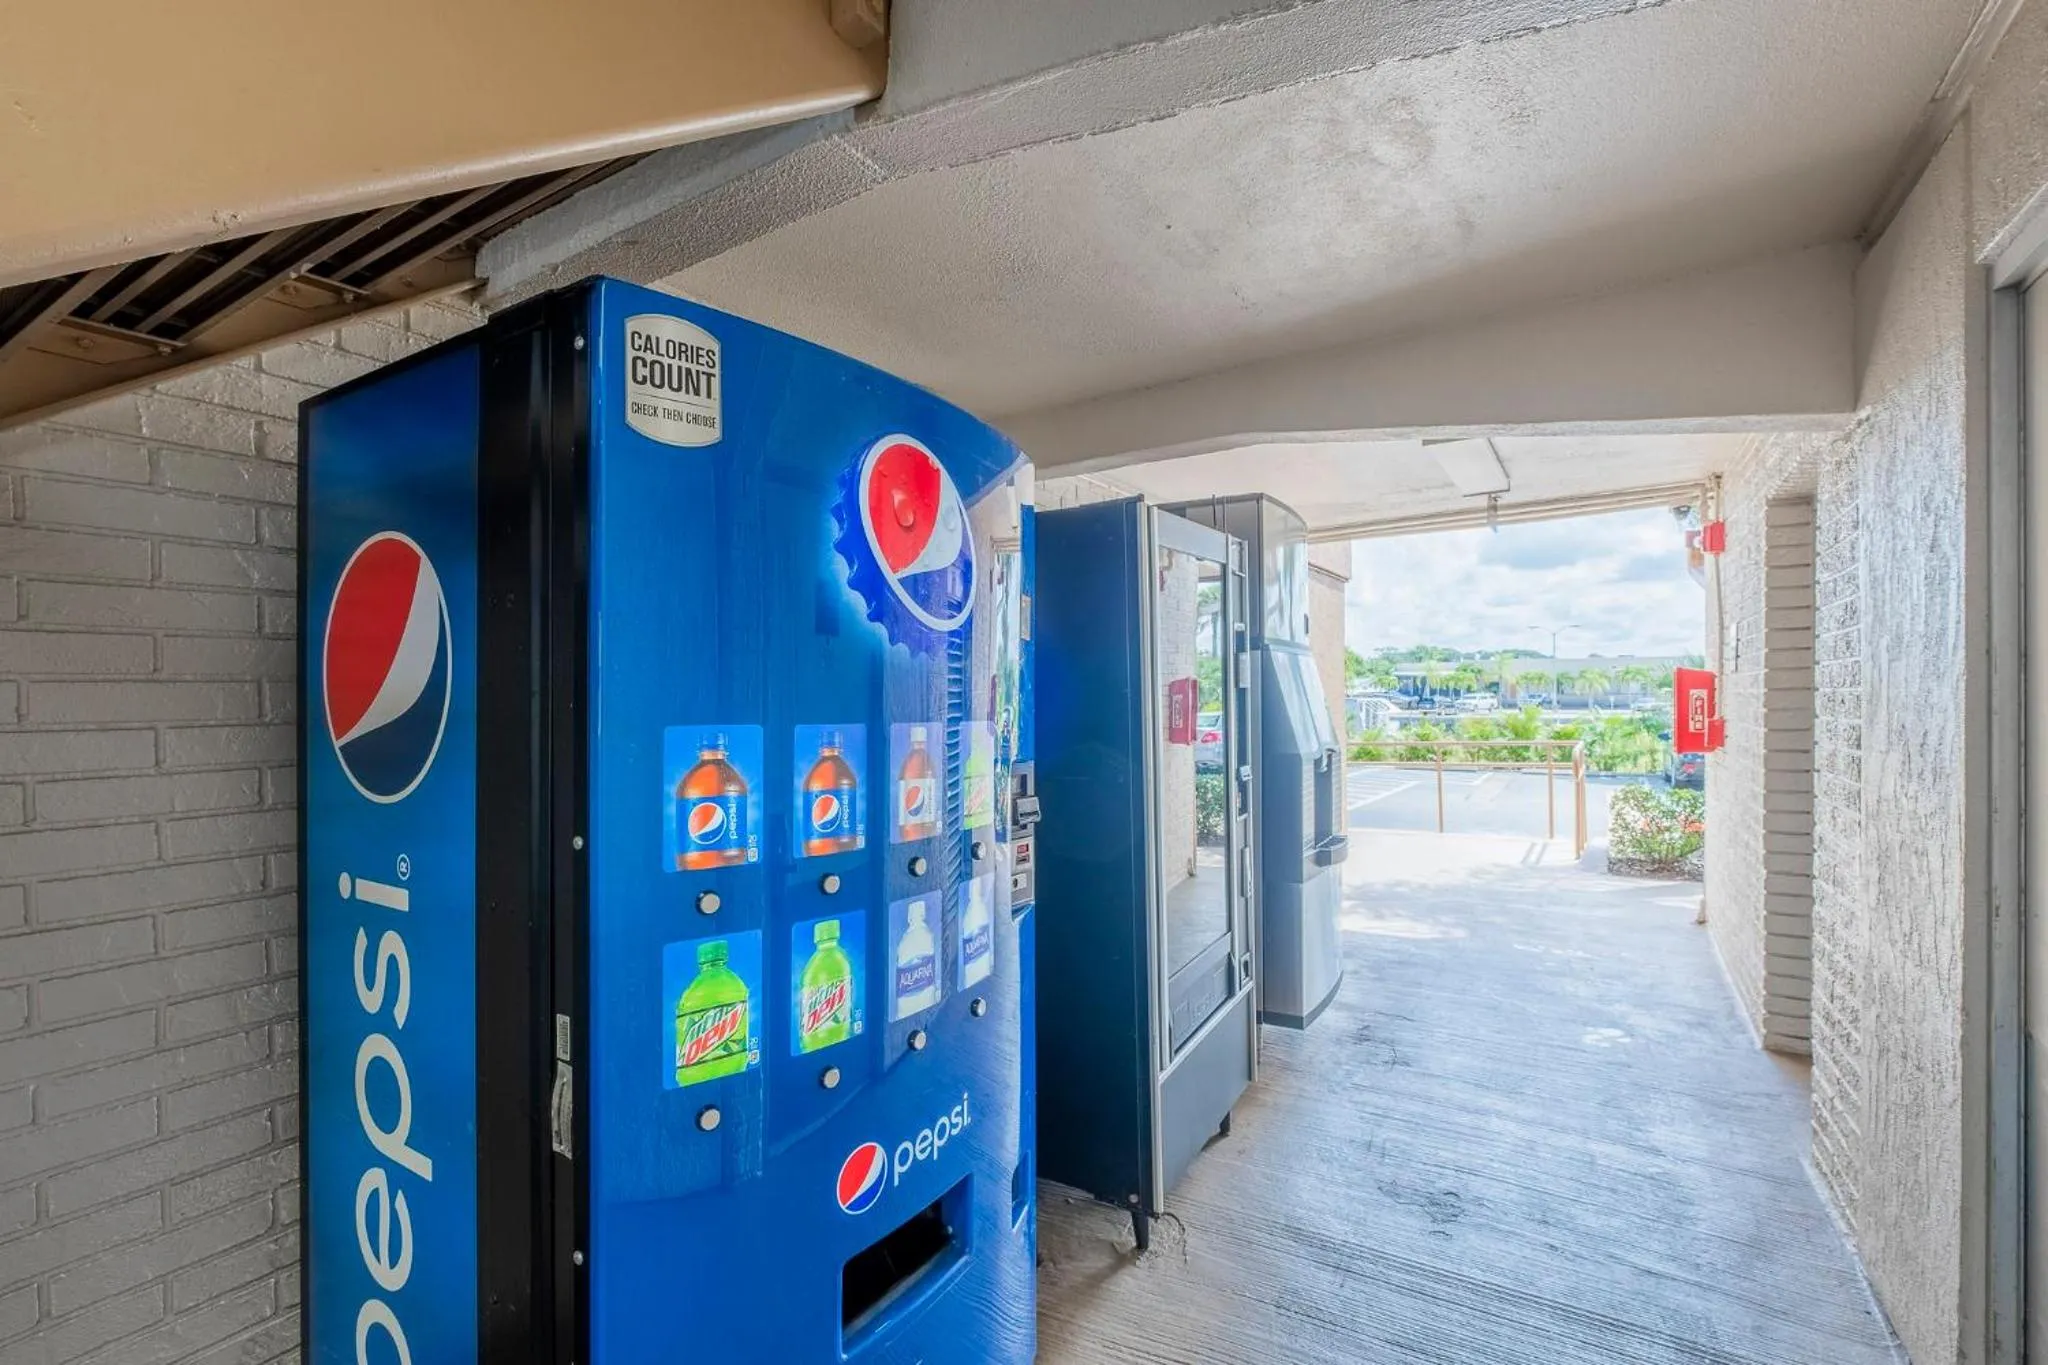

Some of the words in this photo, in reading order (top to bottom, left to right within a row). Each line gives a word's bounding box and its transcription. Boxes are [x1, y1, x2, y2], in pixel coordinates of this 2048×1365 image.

[631, 331, 716, 369] CALORIES
[631, 355, 716, 399] COUNT
[631, 401, 659, 418] CHECK
[662, 406, 683, 422] THEN
[686, 412, 717, 429] CHOOSE
[893, 1091, 968, 1187] pepsi
